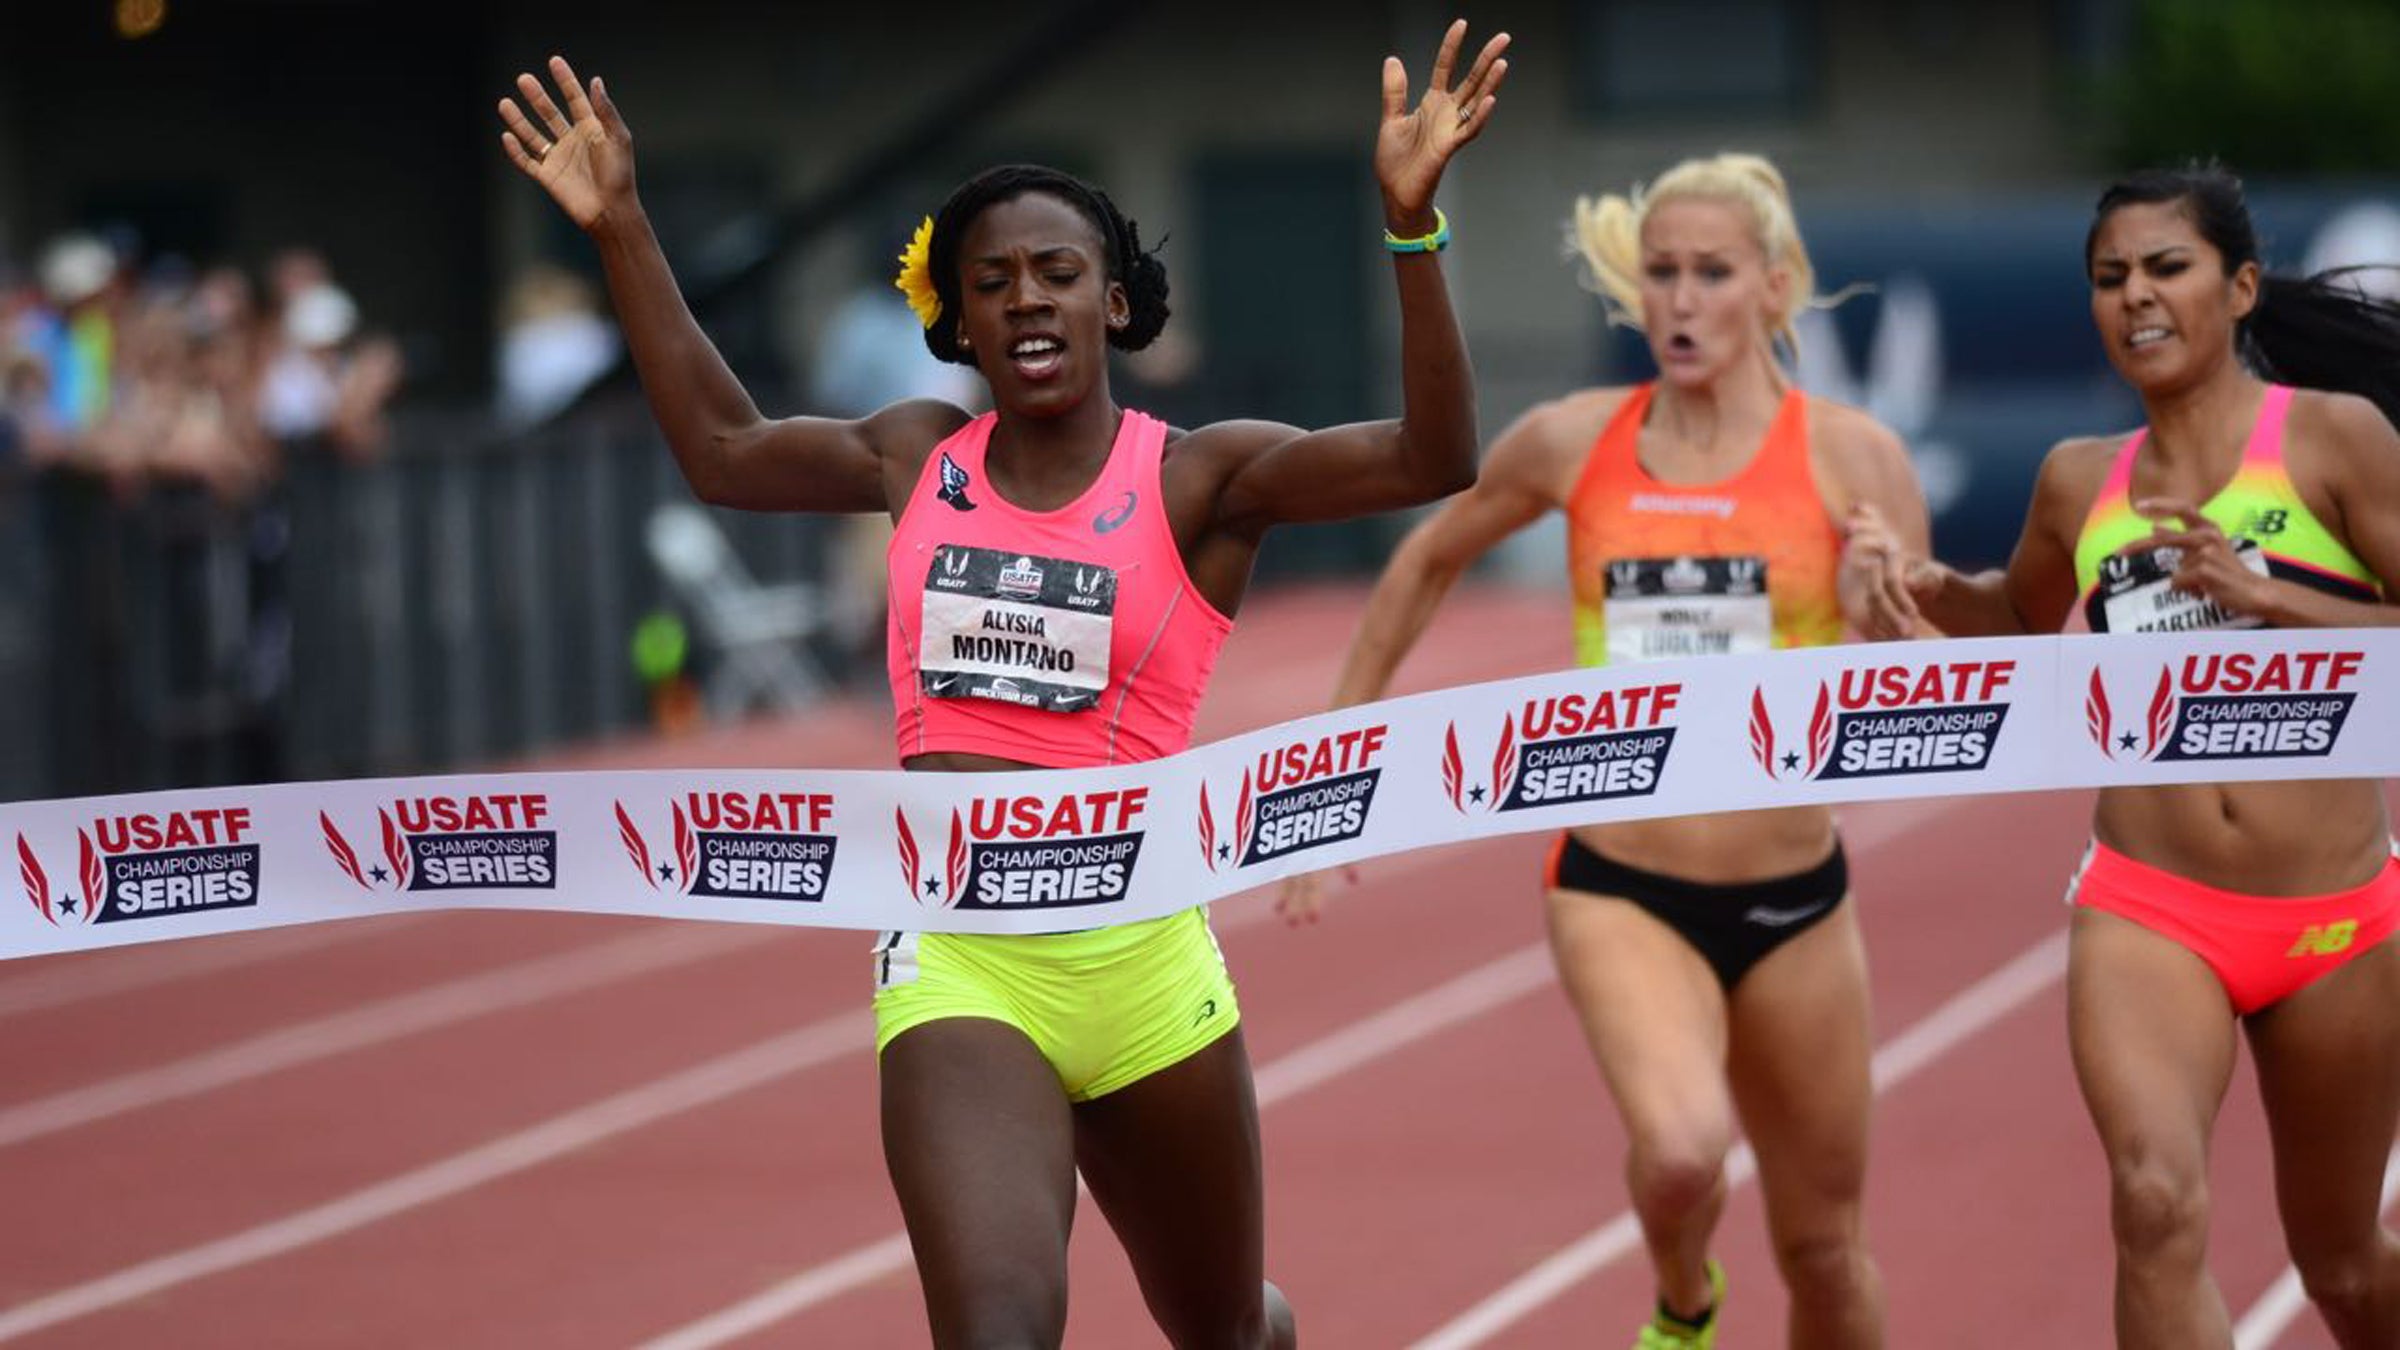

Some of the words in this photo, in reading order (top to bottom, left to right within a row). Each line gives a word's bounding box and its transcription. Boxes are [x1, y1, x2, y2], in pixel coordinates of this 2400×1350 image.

[936, 577, 968, 589] USATF
[1002, 570, 1040, 584] USATF
[1066, 594, 1100, 607] USATF
[952, 634, 1075, 673] MONTANO
[2181, 652, 2365, 694] USATF
[1838, 660, 2016, 709] USATF
[1521, 684, 1682, 740] USATF
[1845, 711, 1998, 738] CHAMPIONSHIP
[2186, 700, 2344, 721] CHAMPIONSHIP
[1527, 736, 1666, 768] CHAMPIONSHIP
[1840, 732, 1987, 772] SERIES
[2180, 719, 2332, 755] SERIES
[1257, 725, 1388, 793] USATF
[1521, 757, 1656, 802] SERIES
[395, 794, 546, 833] USATF
[690, 792, 833, 832] USATF
[970, 786, 1149, 841] USATF
[1261, 778, 1373, 821] CHAMPIONSHIP
[96, 808, 250, 854] USATF
[418, 838, 550, 856] CHAMPIONSHIP
[1257, 800, 1363, 855] SERIES
[115, 852, 253, 879] CHAMPIONSHIP
[706, 838, 830, 860] CHAMPIONSHIP
[979, 841, 1135, 869] CHAMPIONSHIP
[423, 855, 551, 884] SERIES
[707, 857, 823, 895] SERIES
[977, 862, 1125, 904] SERIES
[116, 870, 253, 914] SERIES
